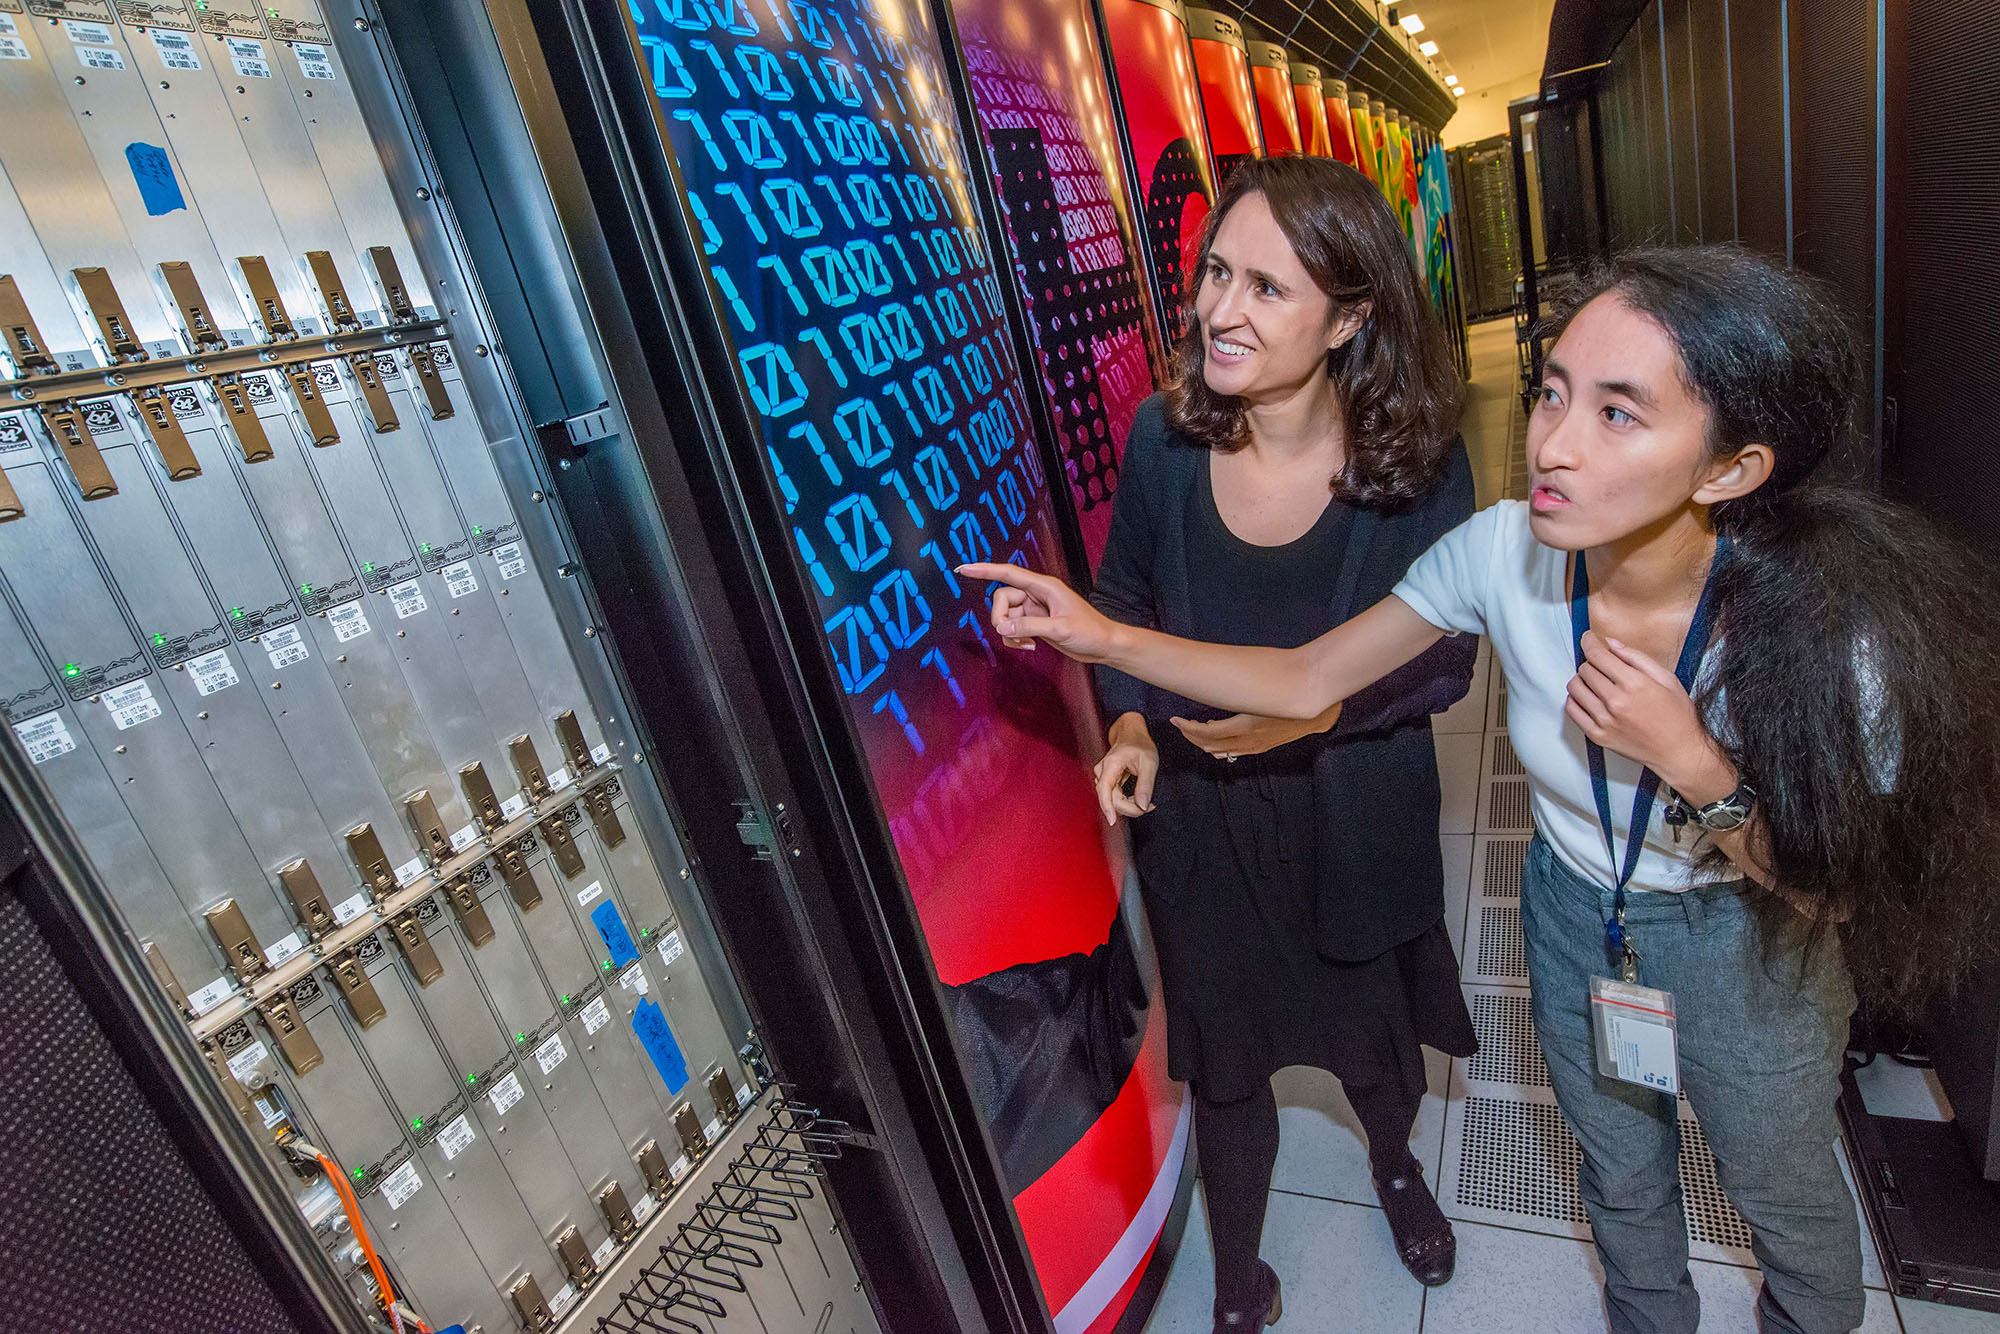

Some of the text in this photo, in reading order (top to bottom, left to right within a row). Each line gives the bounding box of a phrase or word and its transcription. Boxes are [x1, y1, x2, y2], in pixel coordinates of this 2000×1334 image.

[369, 569, 420, 591] COMPUTE MODULE
[306, 598, 337, 614] COMPUTE
[336, 588, 362, 602] MODULE
[237, 622, 272, 639] COMPUTE
[271, 613, 299, 627] MODULE
[160, 649, 197, 666] COMPUTE
[197, 638, 228, 653] MODULE
[73, 679, 116, 698] COMPUTE
[115, 668, 149, 683] MODULE
[22, 700, 61, 717] MODULE
